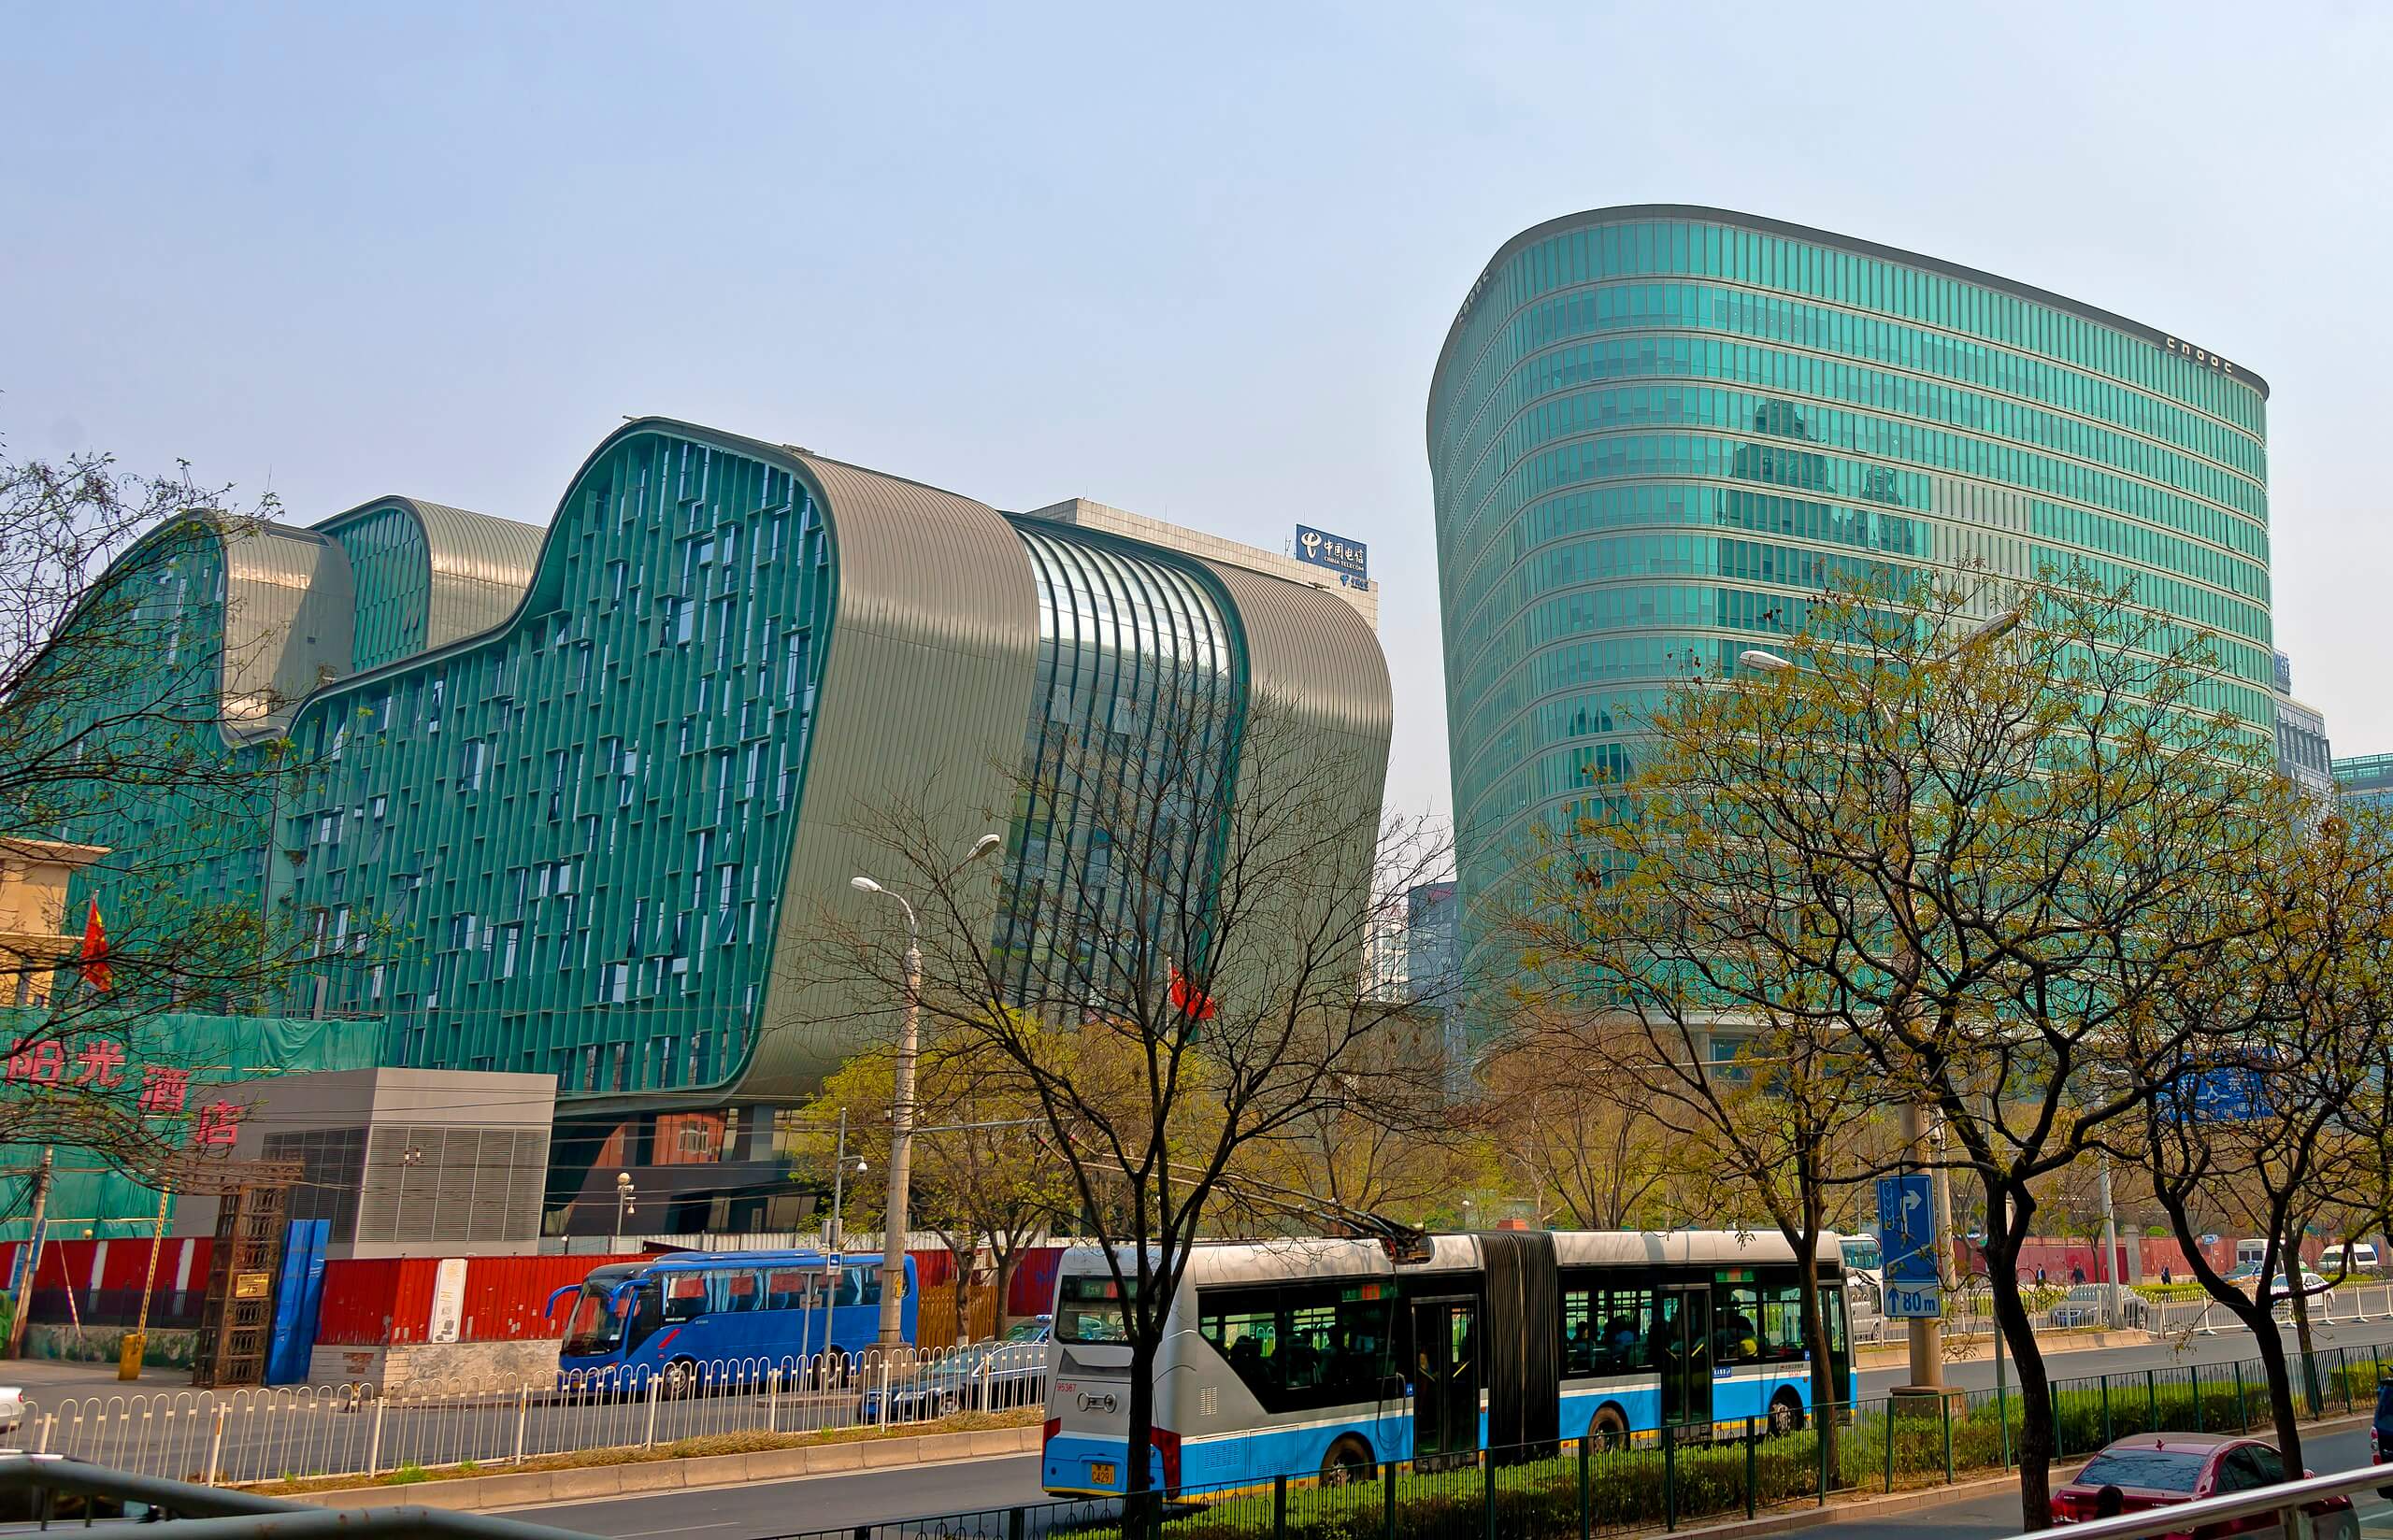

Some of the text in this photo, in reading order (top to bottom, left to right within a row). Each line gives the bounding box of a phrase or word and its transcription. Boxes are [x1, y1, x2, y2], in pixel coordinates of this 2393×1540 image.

[1324, 539, 1364, 564] 中国电信
[1324, 556, 1365, 572] CHINA TELECOM
[6, 1037, 244, 1146] 阳光酒店
